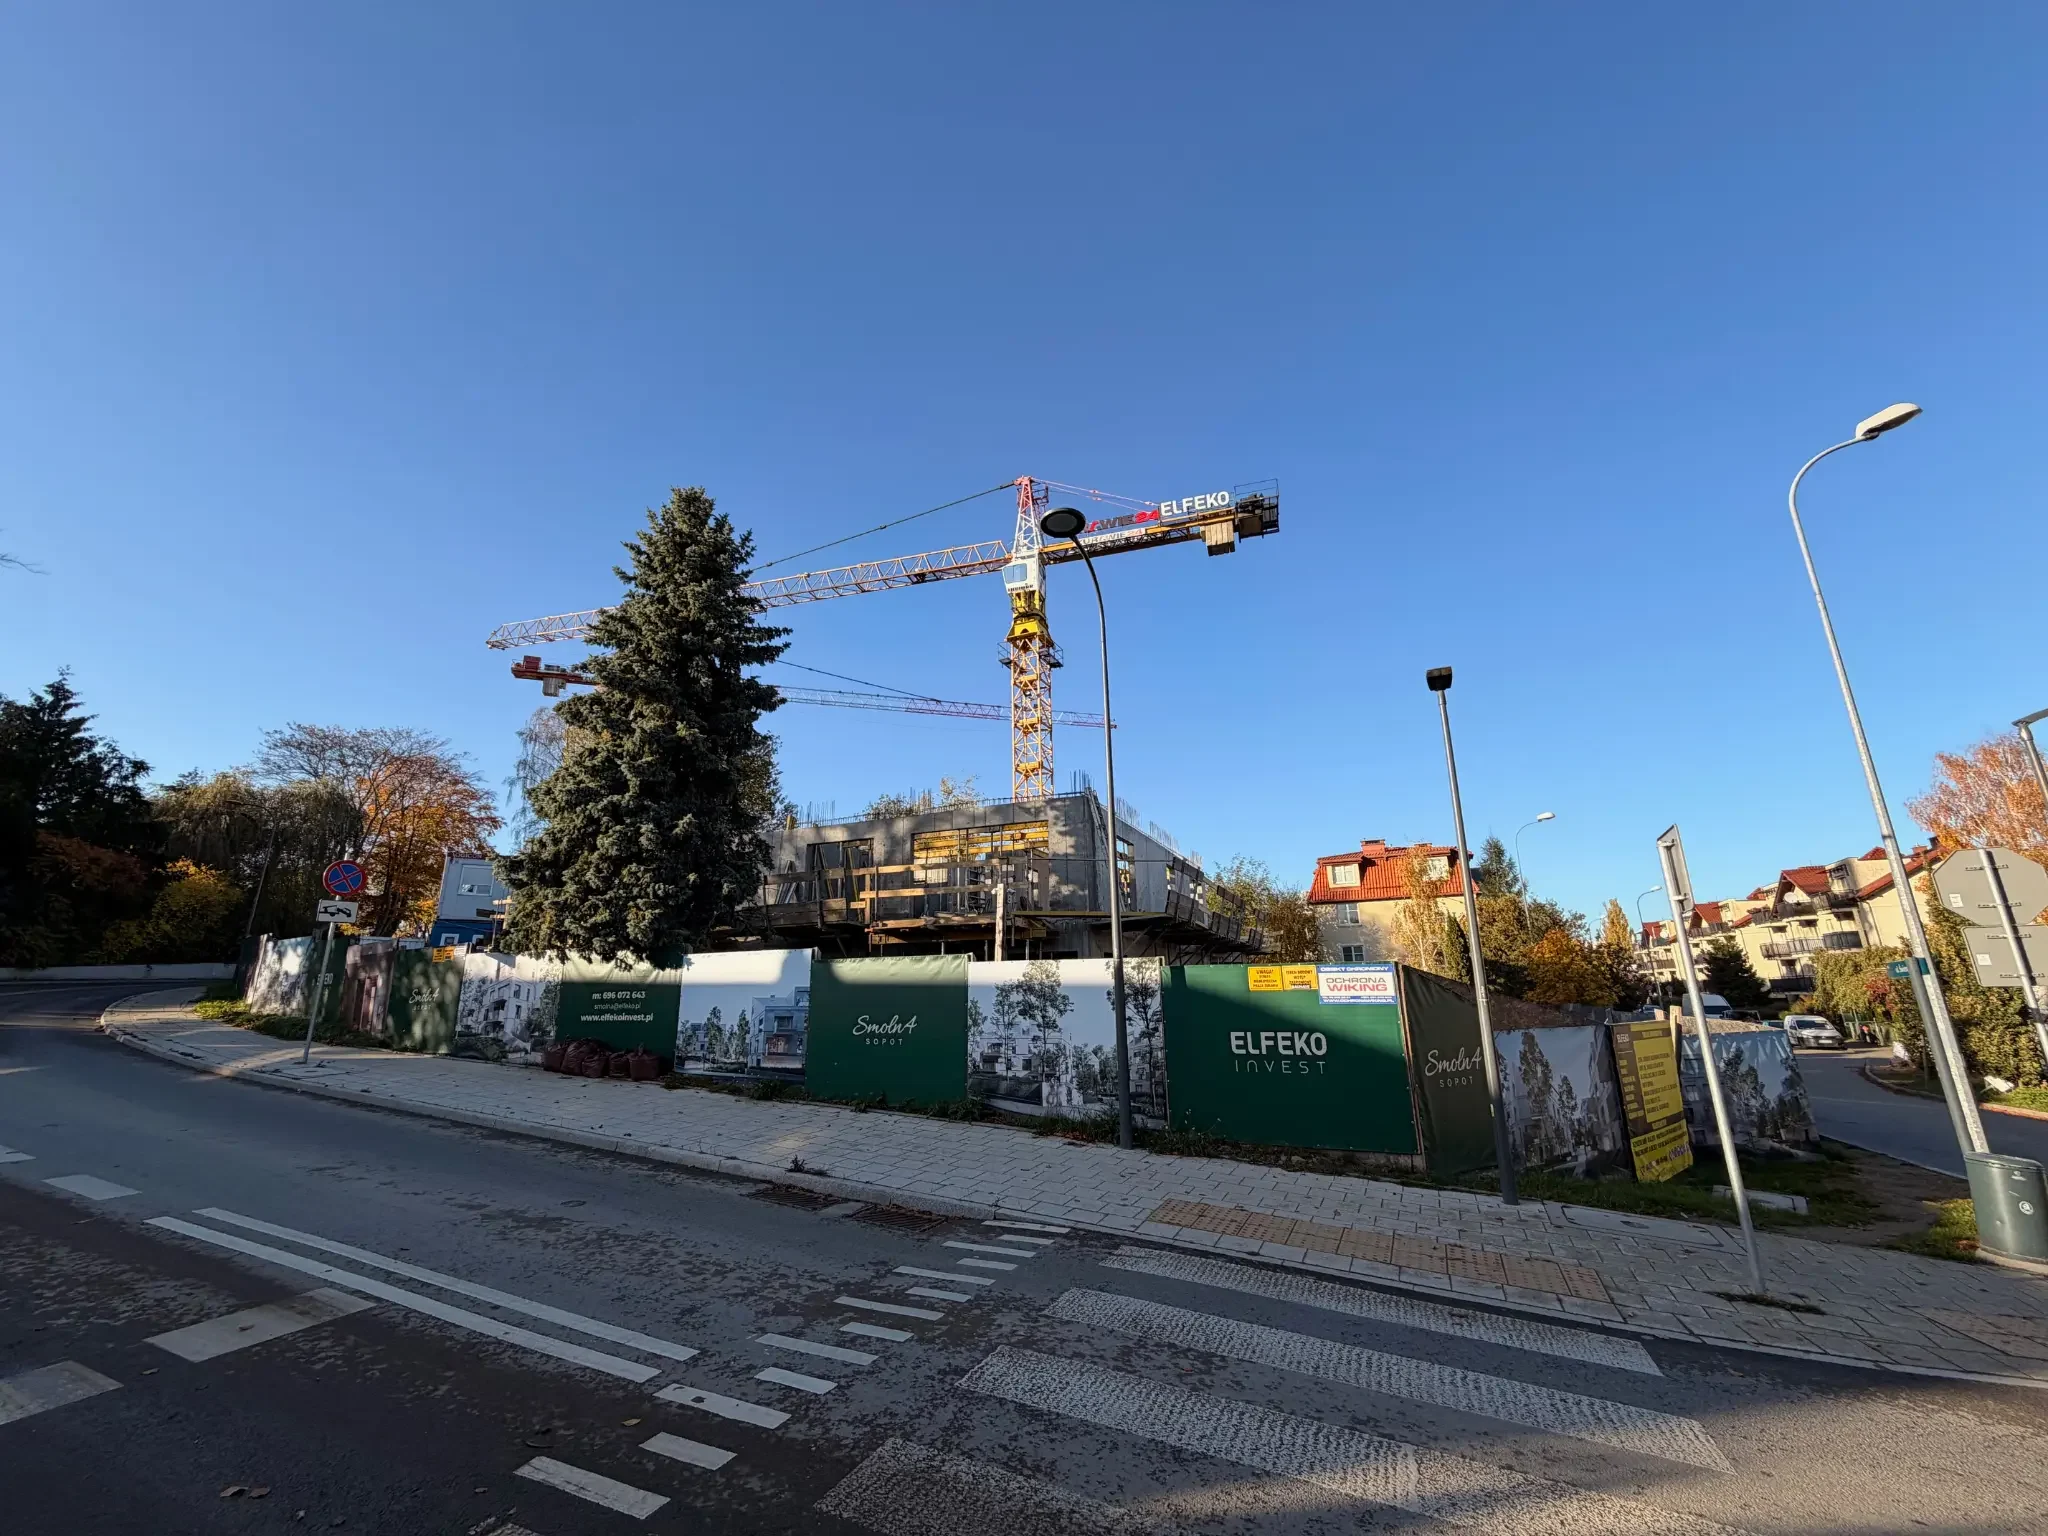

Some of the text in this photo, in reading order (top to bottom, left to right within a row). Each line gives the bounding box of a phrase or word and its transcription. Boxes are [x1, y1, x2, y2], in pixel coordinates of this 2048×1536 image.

[1160, 490, 1230, 517] ELFEKO
[1327, 983, 1388, 992] WIKING
[603, 991, 616, 1000] 696
[617, 991, 631, 999] 072
[632, 991, 646, 999] 643
[580, 1012, 654, 1023] www.elfekoinvest.pl
[865, 1038, 903, 1046] SOPOT
[1229, 1031, 1328, 1056] ELFEKO
[1439, 1075, 1473, 1088] SOPOT
